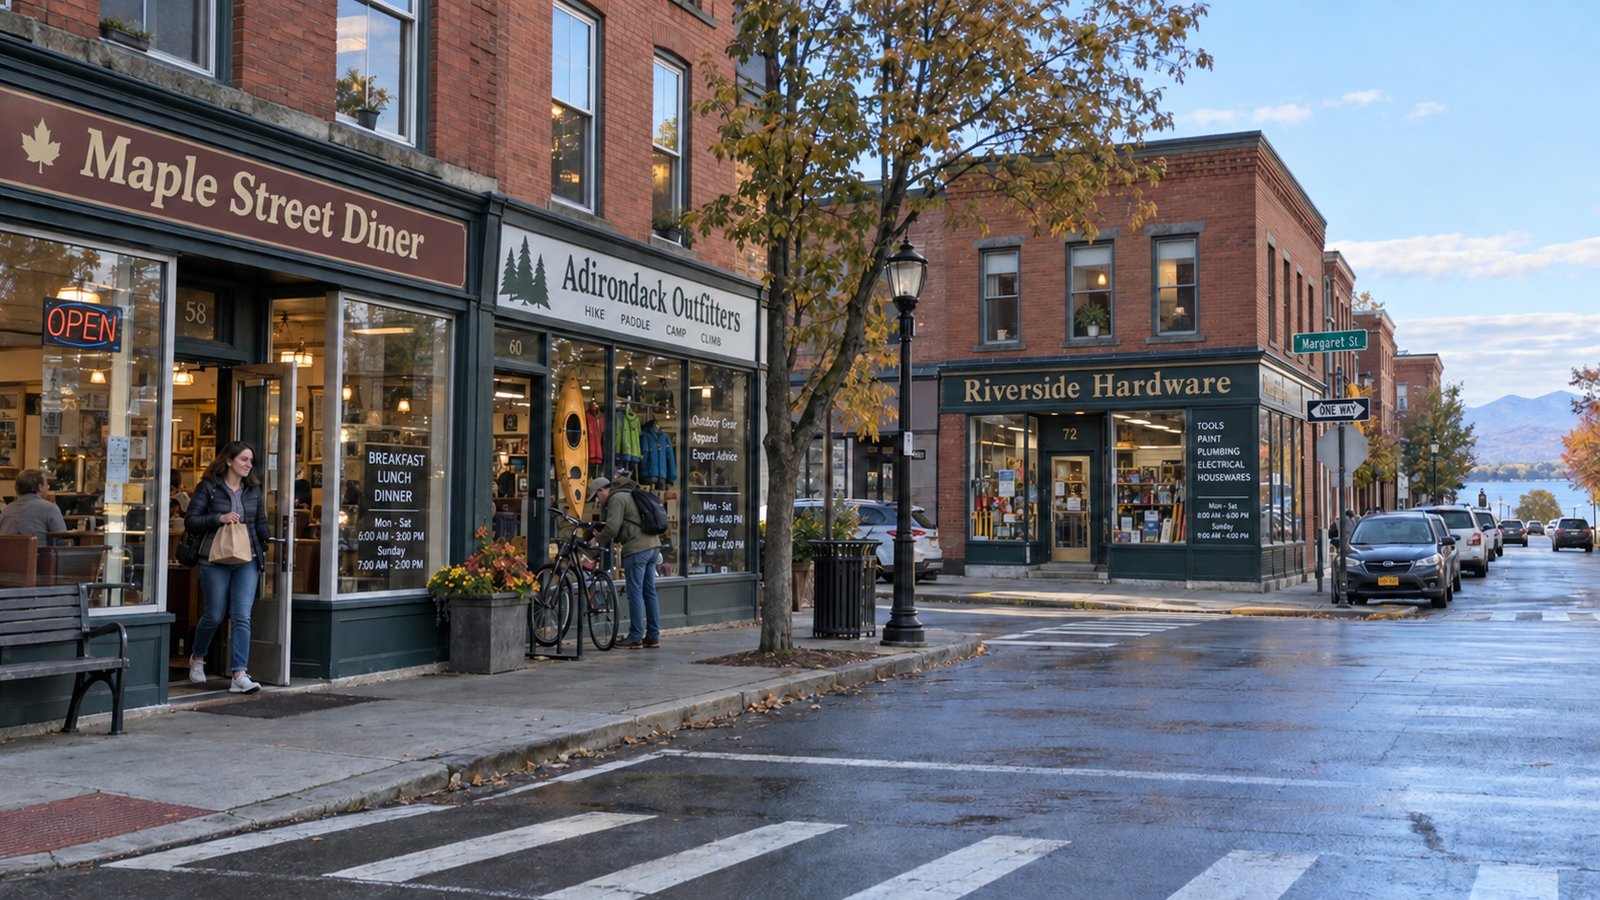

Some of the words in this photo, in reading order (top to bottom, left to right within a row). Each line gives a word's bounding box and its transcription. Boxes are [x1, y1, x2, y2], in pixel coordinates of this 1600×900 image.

[80, 128, 218, 208] Maple
[230, 170, 334, 238] Street
[341, 202, 424, 260] Diner
[562, 254, 667, 314] Adirondack
[672, 286, 741, 332] Outfitters
[186, 301, 206, 324] 58
[47, 307, 117, 342] OPEN
[584, 306, 605, 320] HIKE
[620, 314, 650, 330] PADDLE
[666, 325, 686, 338] CAMP
[701, 333, 722, 346] CLIMB
[509, 340, 522, 356] 60
[1302, 336, 1344, 350] Margaret
[964, 376, 1080, 402] Riverside
[1092, 371, 1232, 398] Hardware
[1320, 403, 1336, 416] ONE
[1340, 403, 1357, 414] WAY
[692, 414, 720, 428] Outdoor
[722, 418, 738, 429] Gear
[1197, 422, 1224, 430] TOOLS
[692, 432, 718, 444] Apparel
[1062, 428, 1077, 440] 72
[1198, 434, 1222, 443] PAINT
[692, 448, 715, 463] Expert
[716, 450, 738, 462] Advice
[1198, 447, 1240, 456] PLUMBING
[368, 452, 425, 466] BREAKFAST
[1198, 460, 1245, 469] ELECTRICAL
[378, 470, 412, 484] LUNCH
[1198, 473, 1251, 482] HOUSEWARES
[374, 489, 412, 502] DINNER
[703, 501, 716, 510] Mon
[722, 502, 732, 511] Sat
[374, 518, 392, 527] Mon
[399, 518, 411, 527] Sat
[691, 514, 704, 523] 9:00
[720, 515, 732, 523] 6:00
[734, 515, 743, 523] PM
[1212, 523, 1234, 532] Sunday
[358, 531, 375, 541] 6:00
[376, 532, 388, 541] AM
[396, 532, 411, 541] 3:00
[413, 532, 424, 541] PM
[707, 528, 728, 540] Sunday
[377, 545, 406, 558] Sunday
[691, 541, 706, 550] 10:00
[707, 541, 717, 550] AM
[735, 541, 744, 549] PM
[358, 560, 374, 570] 7:00
[375, 561, 388, 569] AM
[395, 560, 410, 569] 2:00
[412, 560, 423, 569] PM
